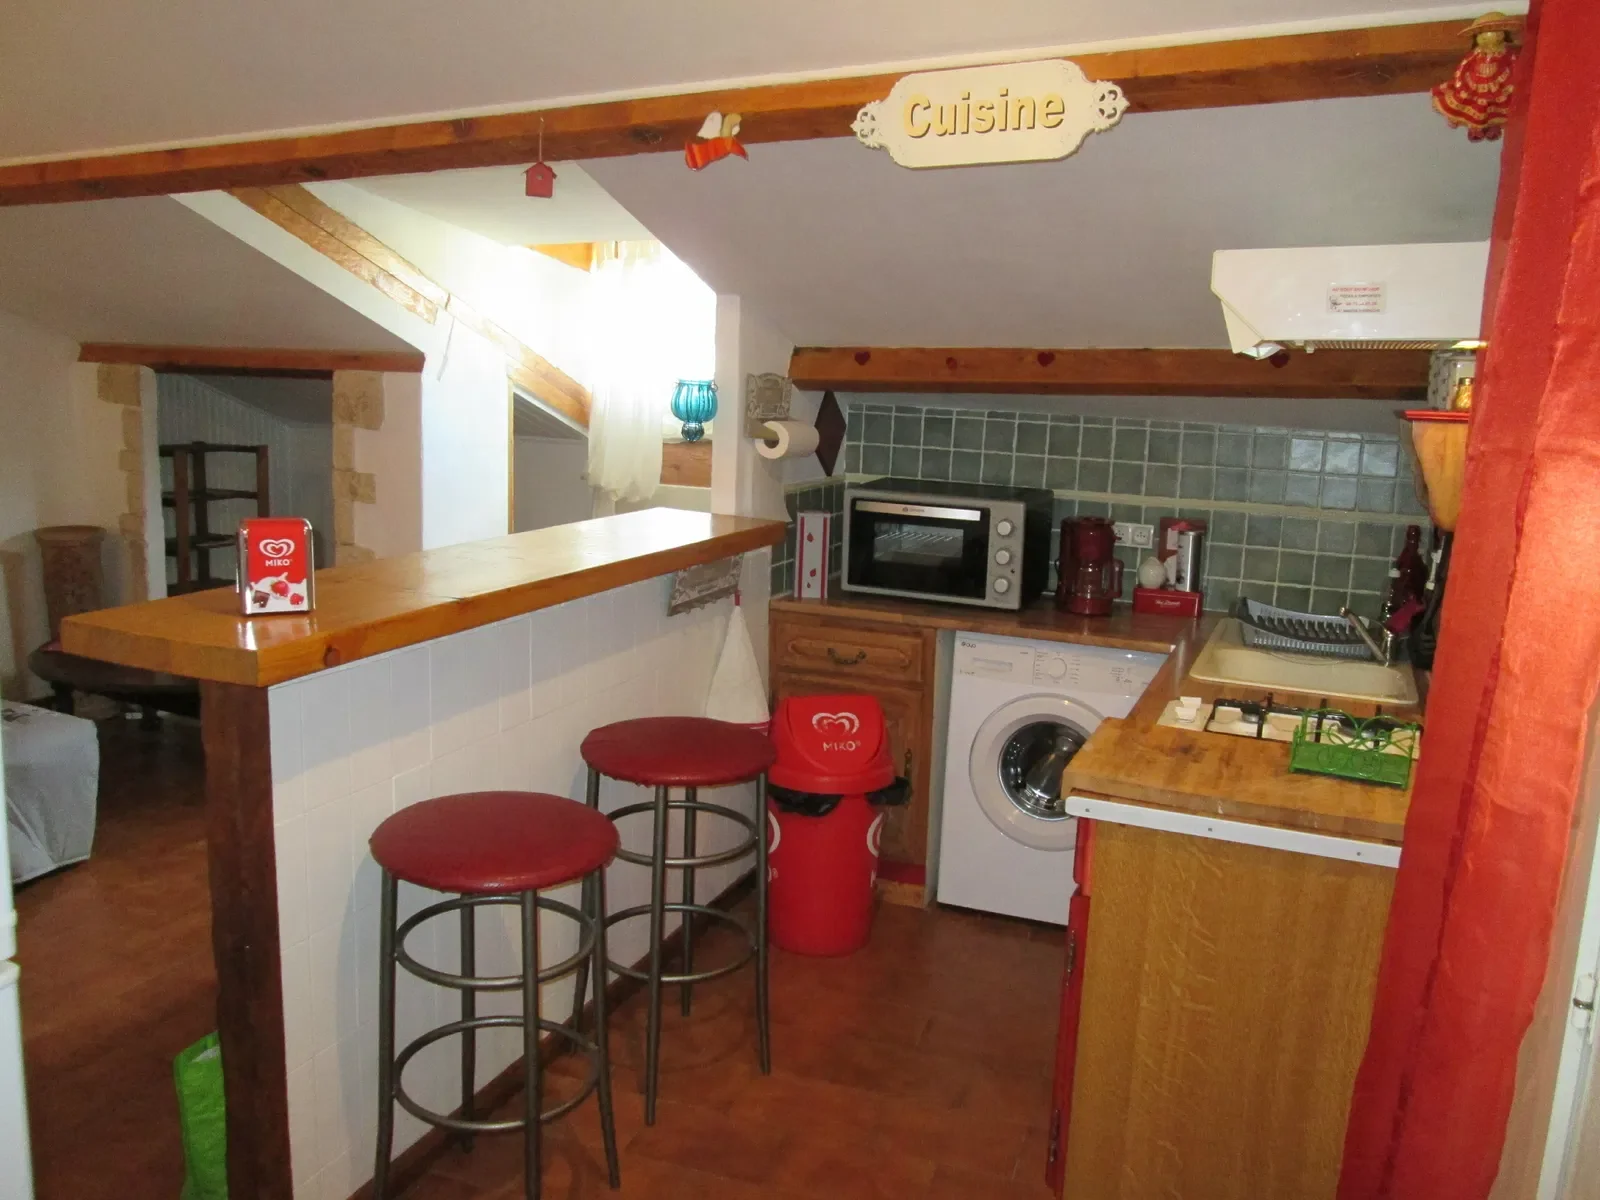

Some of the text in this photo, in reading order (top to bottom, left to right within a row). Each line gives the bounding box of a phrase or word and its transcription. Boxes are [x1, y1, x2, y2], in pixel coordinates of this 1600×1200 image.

[903, 88, 1065, 138] Cuisine
[265, 559, 290, 567] MIKO
[823, 741, 856, 752] MIKO
